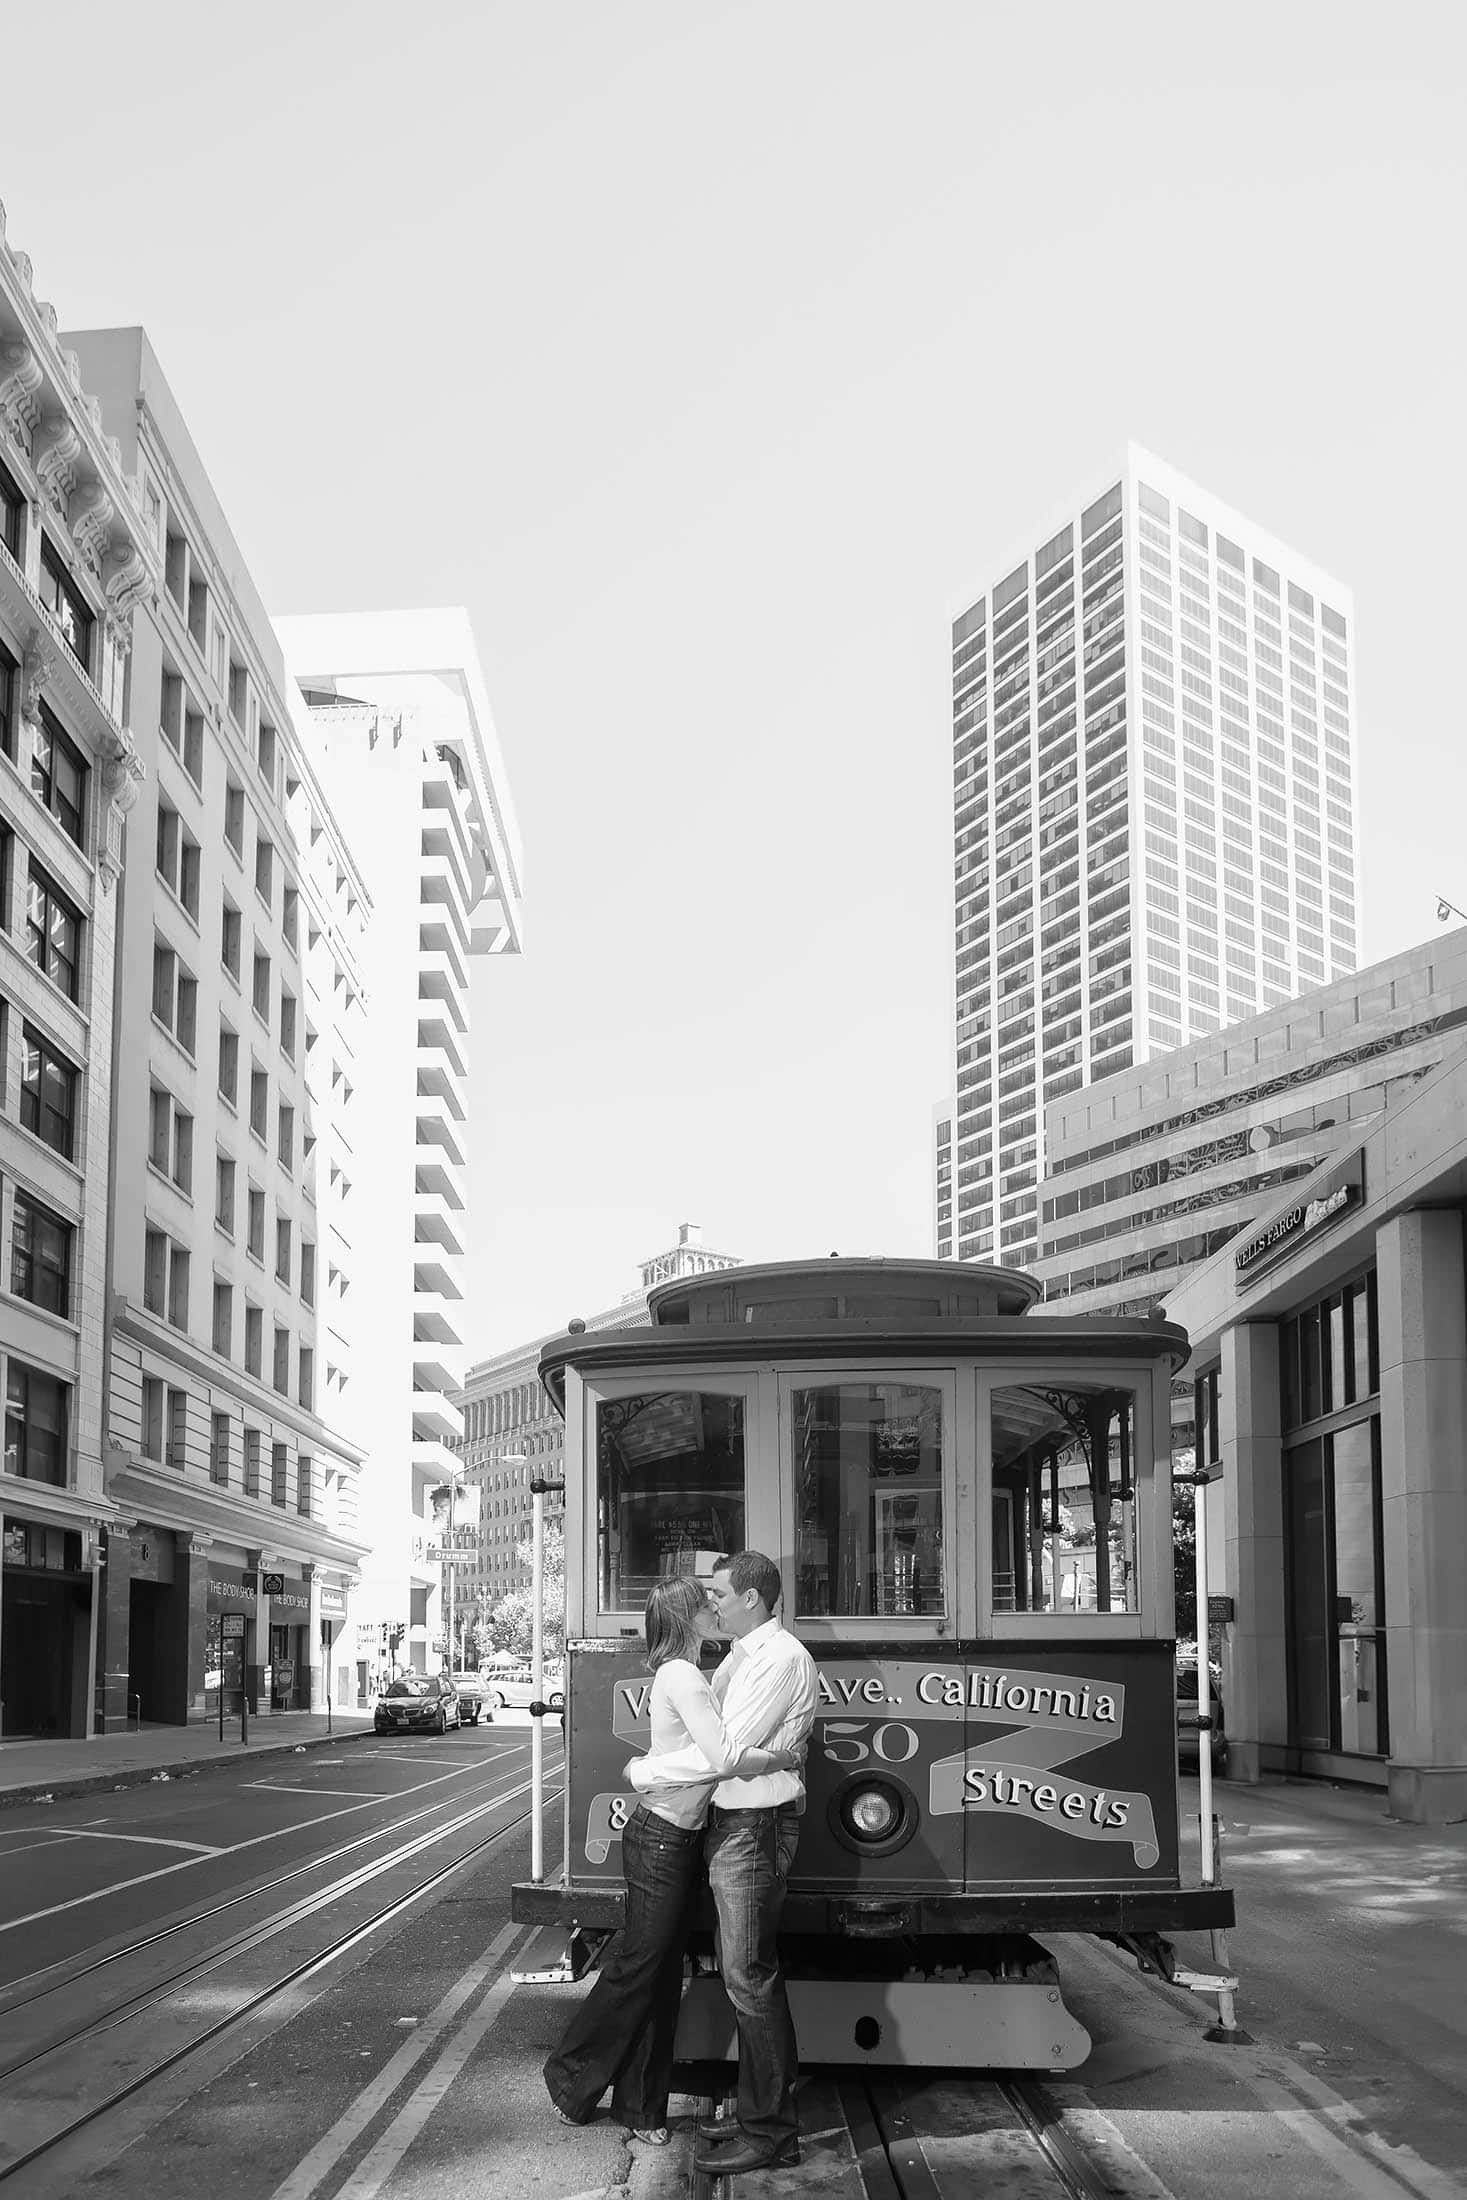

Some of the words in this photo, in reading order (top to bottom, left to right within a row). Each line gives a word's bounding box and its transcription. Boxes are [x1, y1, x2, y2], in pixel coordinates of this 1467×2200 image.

[1235, 1239, 1266, 1268] WELLS
[1266, 1206, 1302, 1246] FARGO
[143, 1543, 151, 1561] 8
[435, 1551, 469, 1560] Drumm
[210, 1580, 222, 1596] THE
[222, 1582, 240, 1598] BODY
[917, 1672, 1117, 1722] California
[823, 1722, 919, 1763] 50
[608, 1798, 630, 1830] &
[962, 1768, 1130, 1829] Streets
